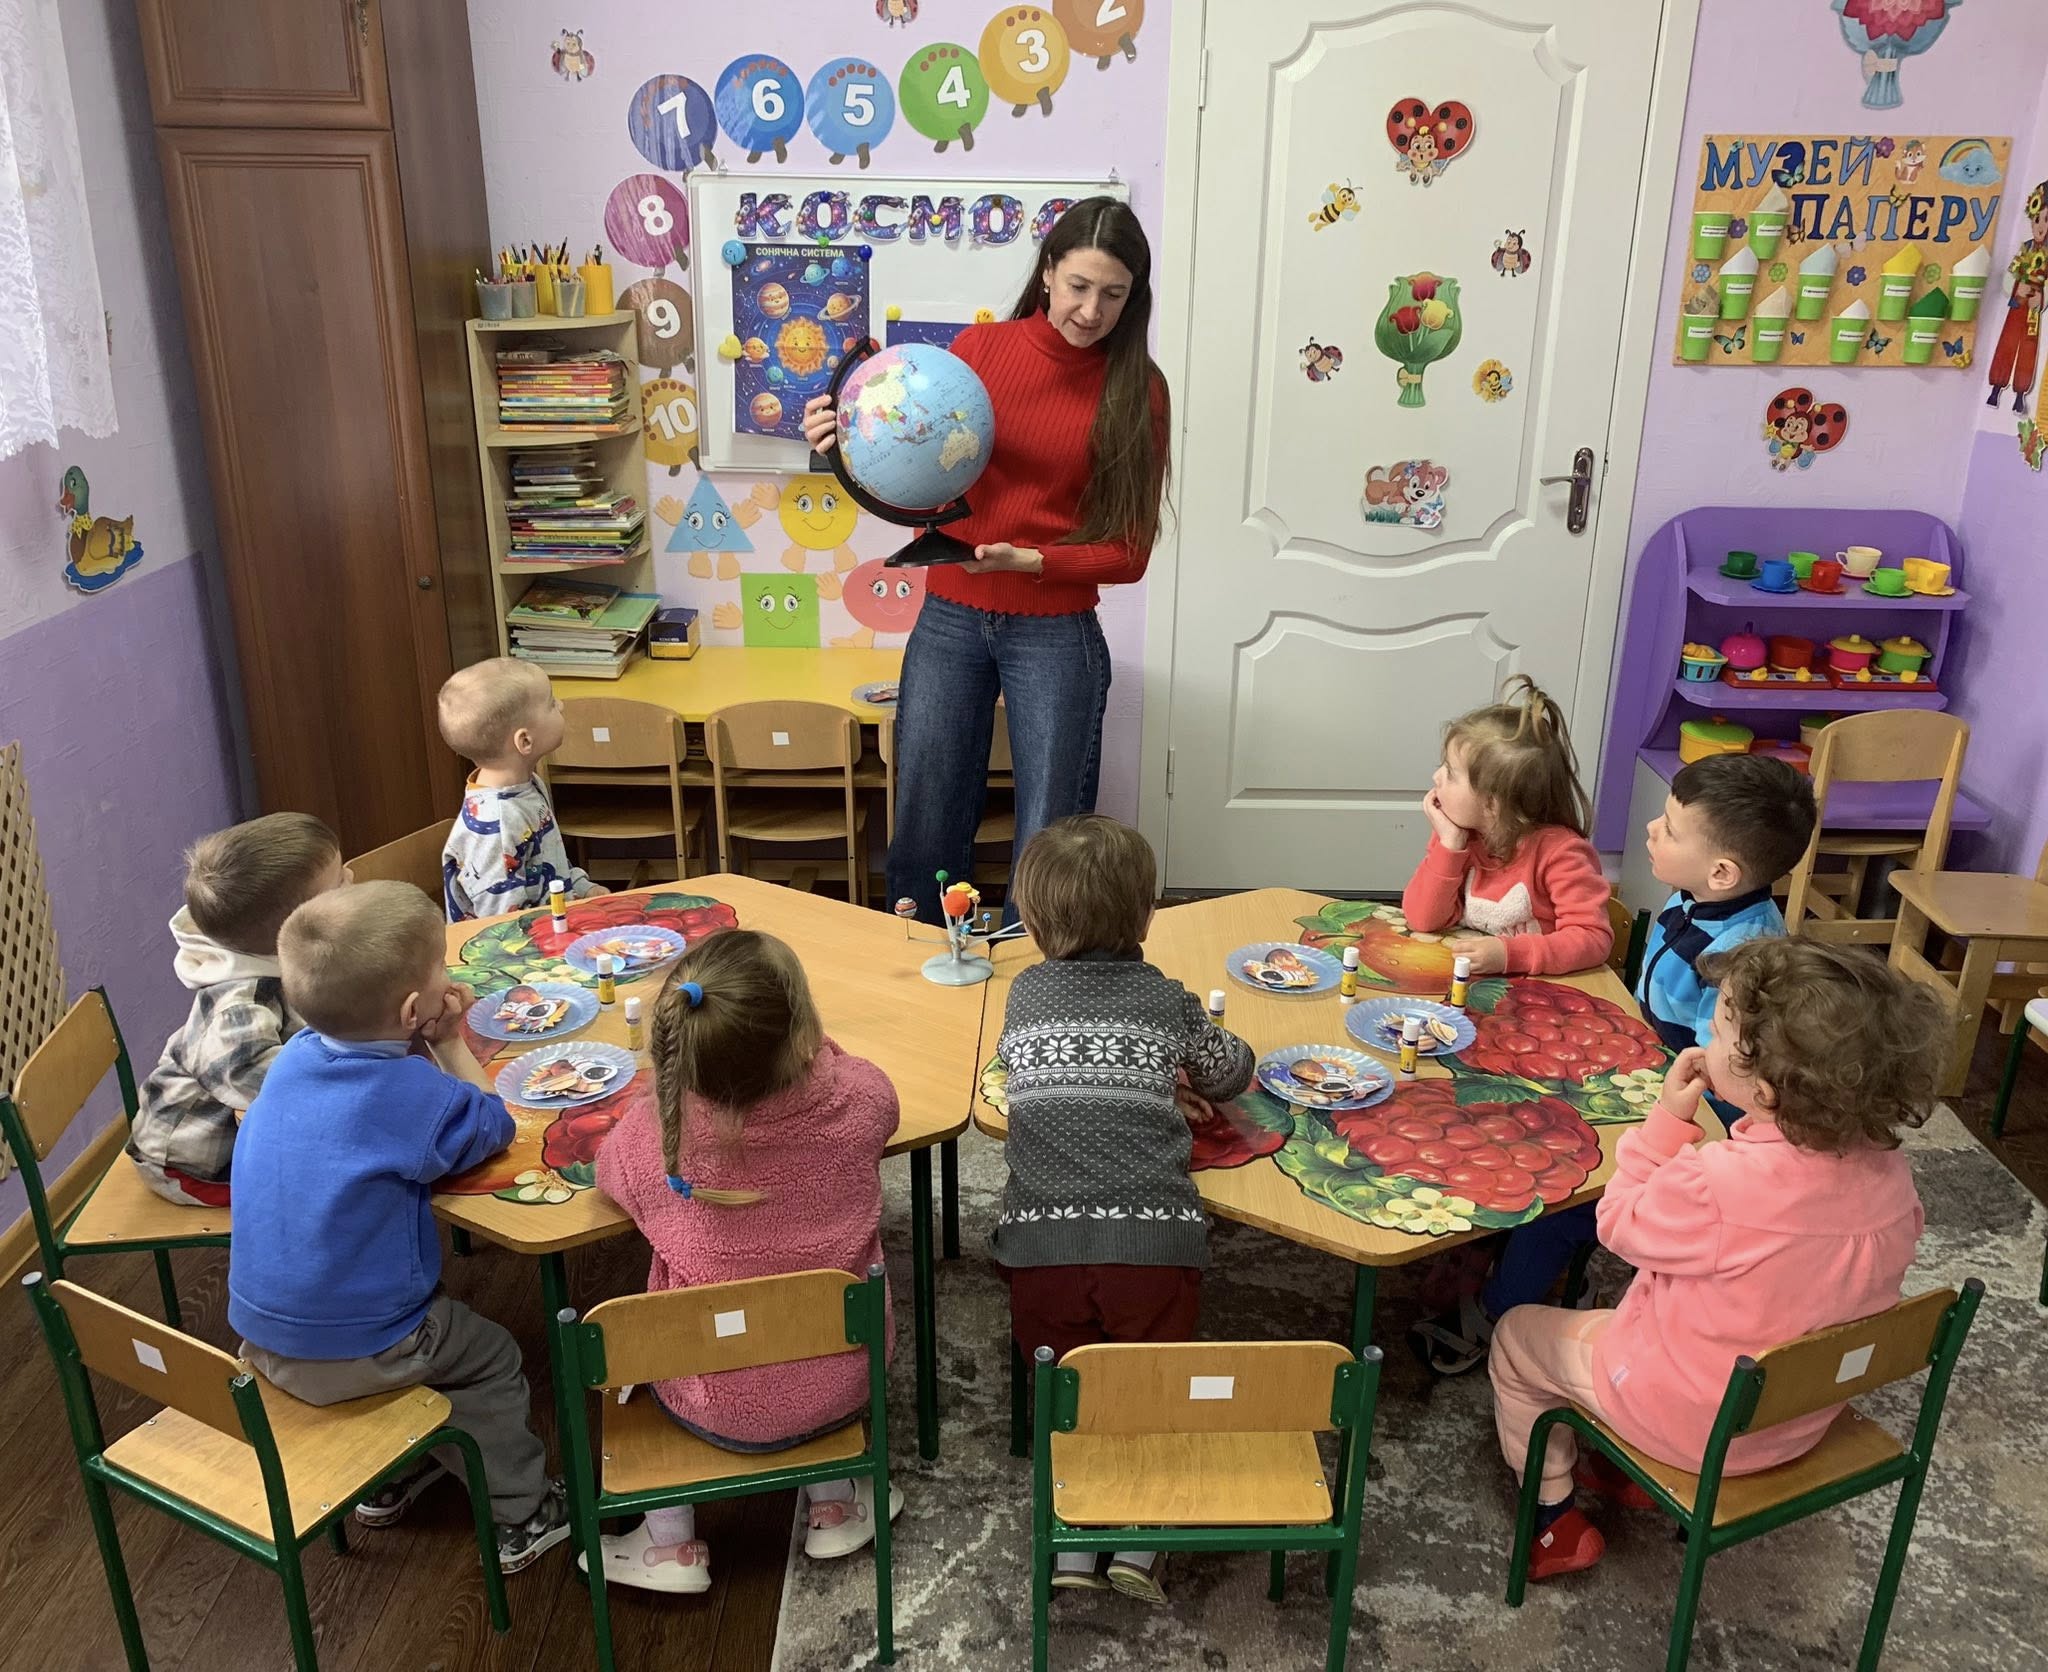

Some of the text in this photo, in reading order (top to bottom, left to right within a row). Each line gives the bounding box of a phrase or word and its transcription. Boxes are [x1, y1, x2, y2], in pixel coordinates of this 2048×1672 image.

[1015, 29, 1050, 73] 3
[751, 78, 785, 122] 6
[841, 83, 876, 127] 5
[936, 65, 971, 109] 4
[656, 91, 691, 140] 7
[1700, 136, 1876, 191] МУЗЕЙ
[637, 194, 674, 237] 8
[1791, 193, 2000, 243] ПАПЕРУ
[755, 247, 845, 258] СОНЯЧНА СИСТЕМА
[647, 298, 681, 339] 9
[650, 397, 698, 441] 10
